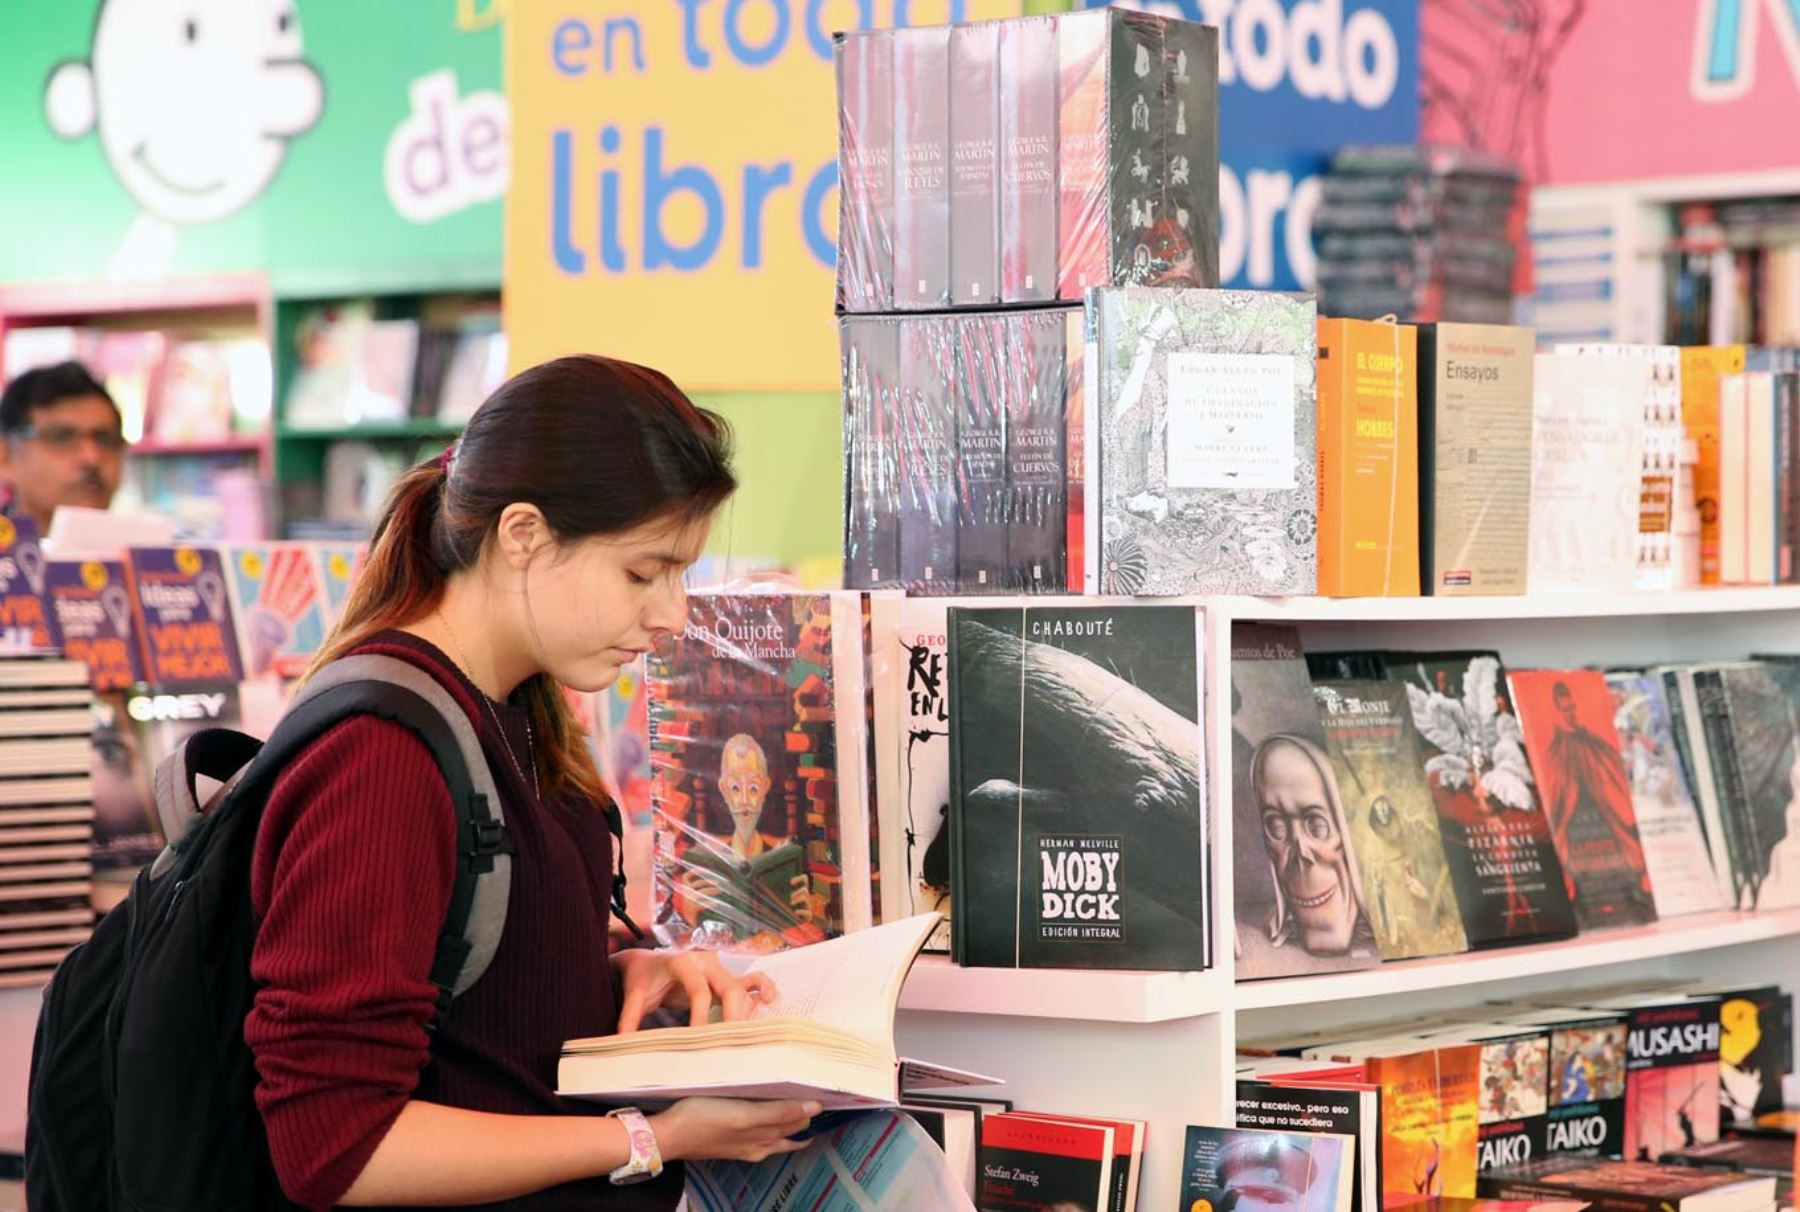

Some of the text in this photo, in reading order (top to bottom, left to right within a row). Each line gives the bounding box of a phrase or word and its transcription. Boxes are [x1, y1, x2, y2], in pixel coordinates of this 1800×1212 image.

[552, 17, 645, 75] en
[954, 147, 995, 161] MARTIN
[1008, 143, 1049, 157] MARTIN
[1445, 360, 1500, 386] Ensayos
[961, 436, 1001, 448] MARTIN
[1015, 435, 1057, 448] MARTIN
[1012, 461, 1060, 474] CUERVOS
[715, 615, 784, 645] Quijote
[1033, 617, 1114, 637] CHABOUTÉ
[744, 642, 796, 659] Mancha
[1263, 642, 1276, 658] de
[1276, 643, 1295, 658] Poe
[127, 692, 227, 722] GREY
[1040, 838, 1120, 849] HERMAN MELVILLE
[1041, 850, 1121, 892] MOBY
[1041, 893, 1121, 921] DICK
[1041, 926, 1121, 939] EDICIÓN INTEGRAL
[1307, 1105, 1330, 1115] pero
[1332, 1106, 1350, 1115] eso
[1258, 1116, 1275, 1126] que
[1276, 1117, 1288, 1125] no
[1289, 1117, 1334, 1128] sucediera
[984, 1164, 1040, 1187] Stefan Zweig
